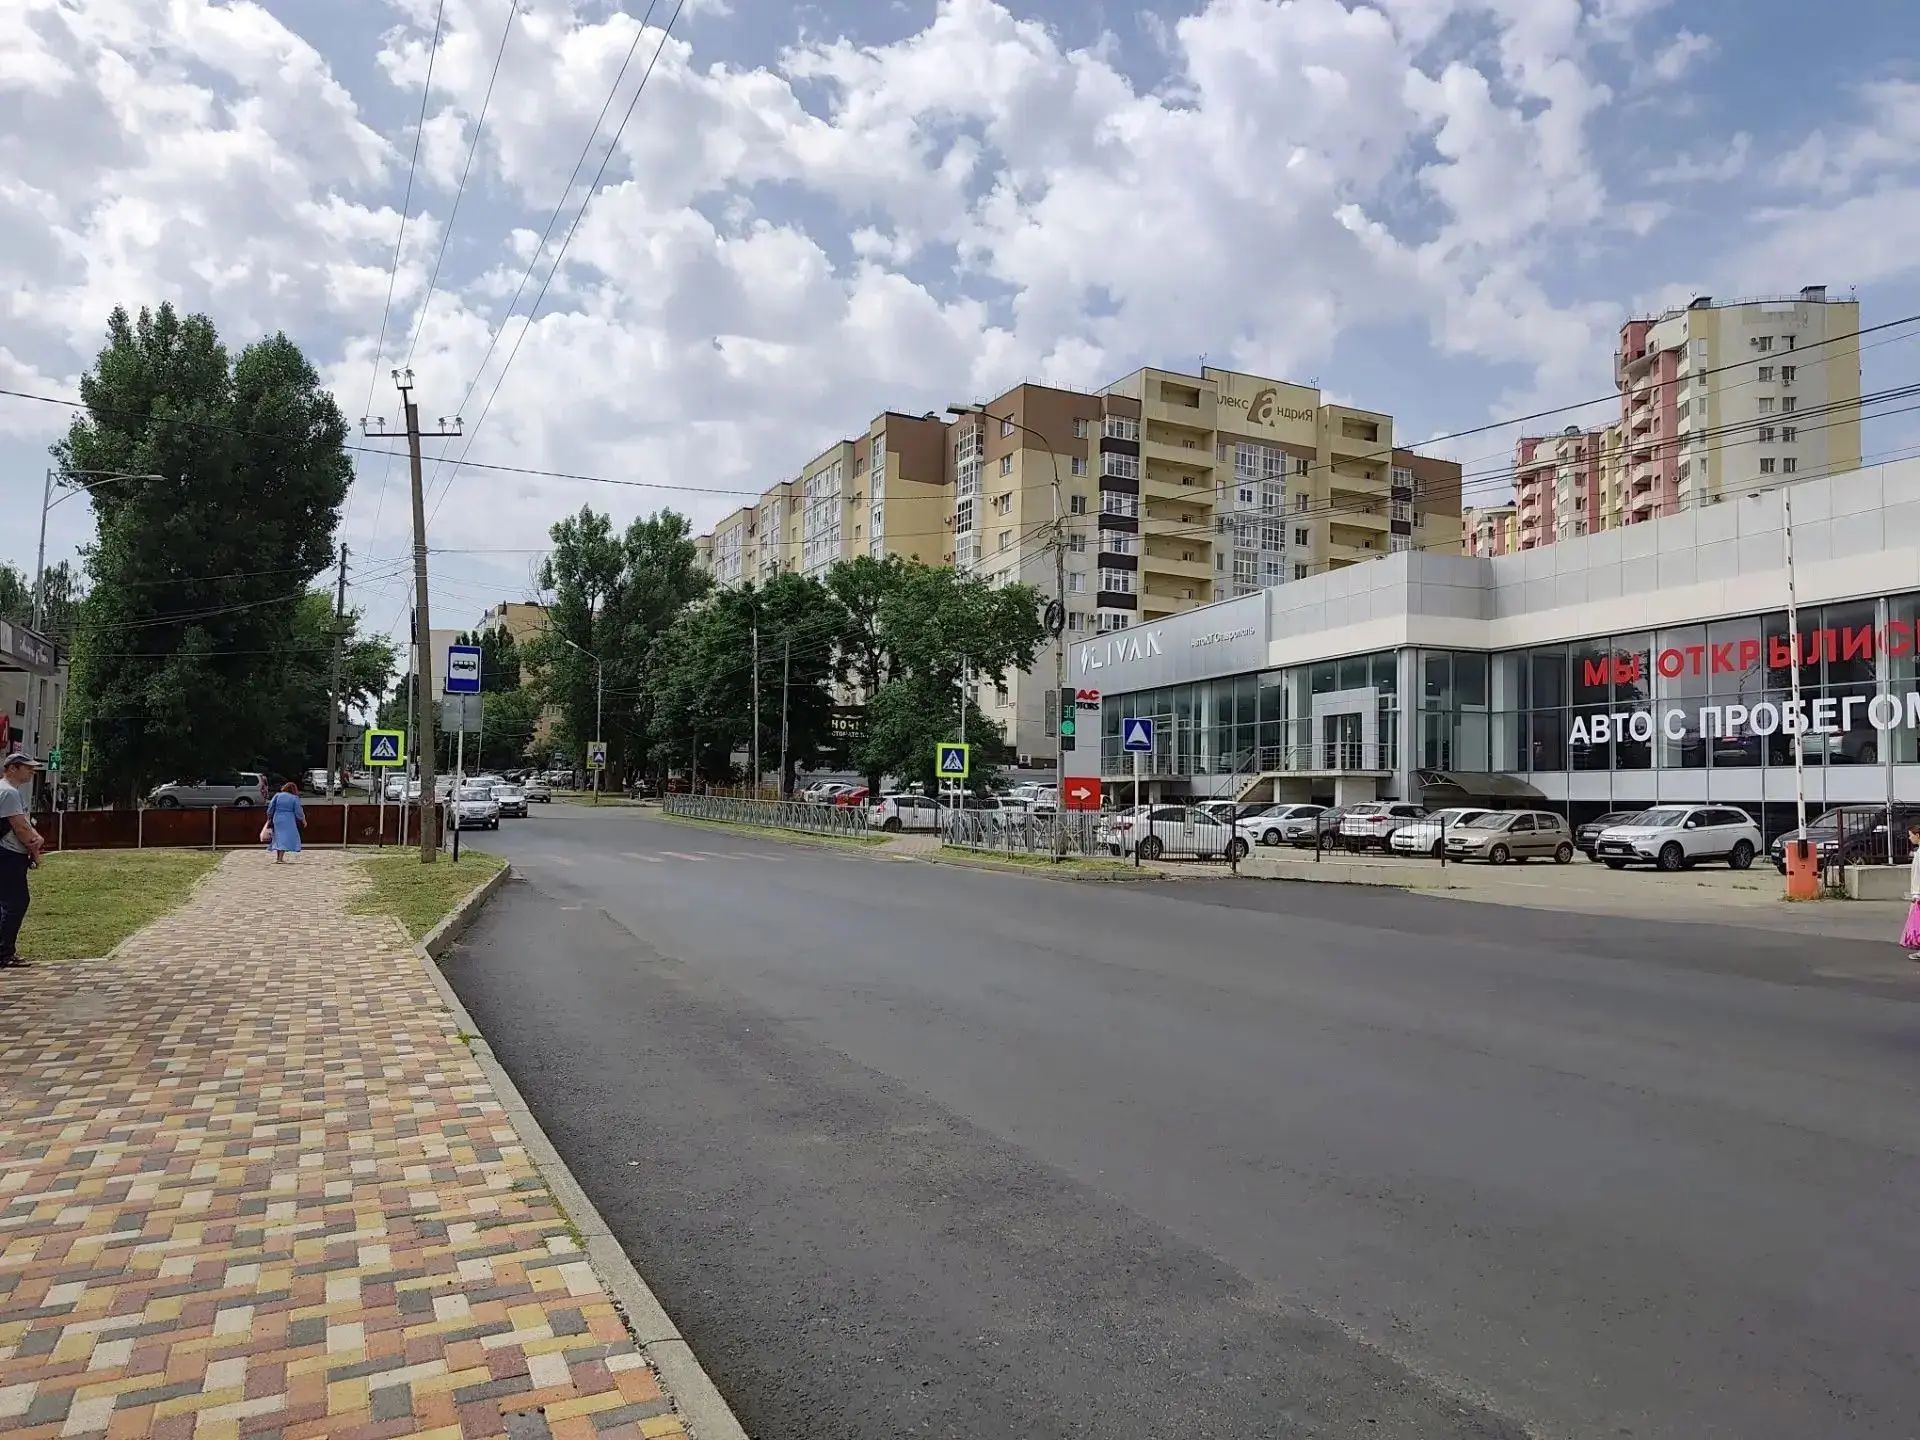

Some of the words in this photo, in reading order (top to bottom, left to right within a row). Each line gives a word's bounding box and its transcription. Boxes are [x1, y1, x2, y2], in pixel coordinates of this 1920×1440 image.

[1583, 654, 1642, 687] МЫ
[1657, 617, 1920, 679] ОТКРЫЛИС
[1063, 705, 1075, 718] 30
[1568, 710, 1653, 745] АВТО
[1663, 708, 1687, 741] С
